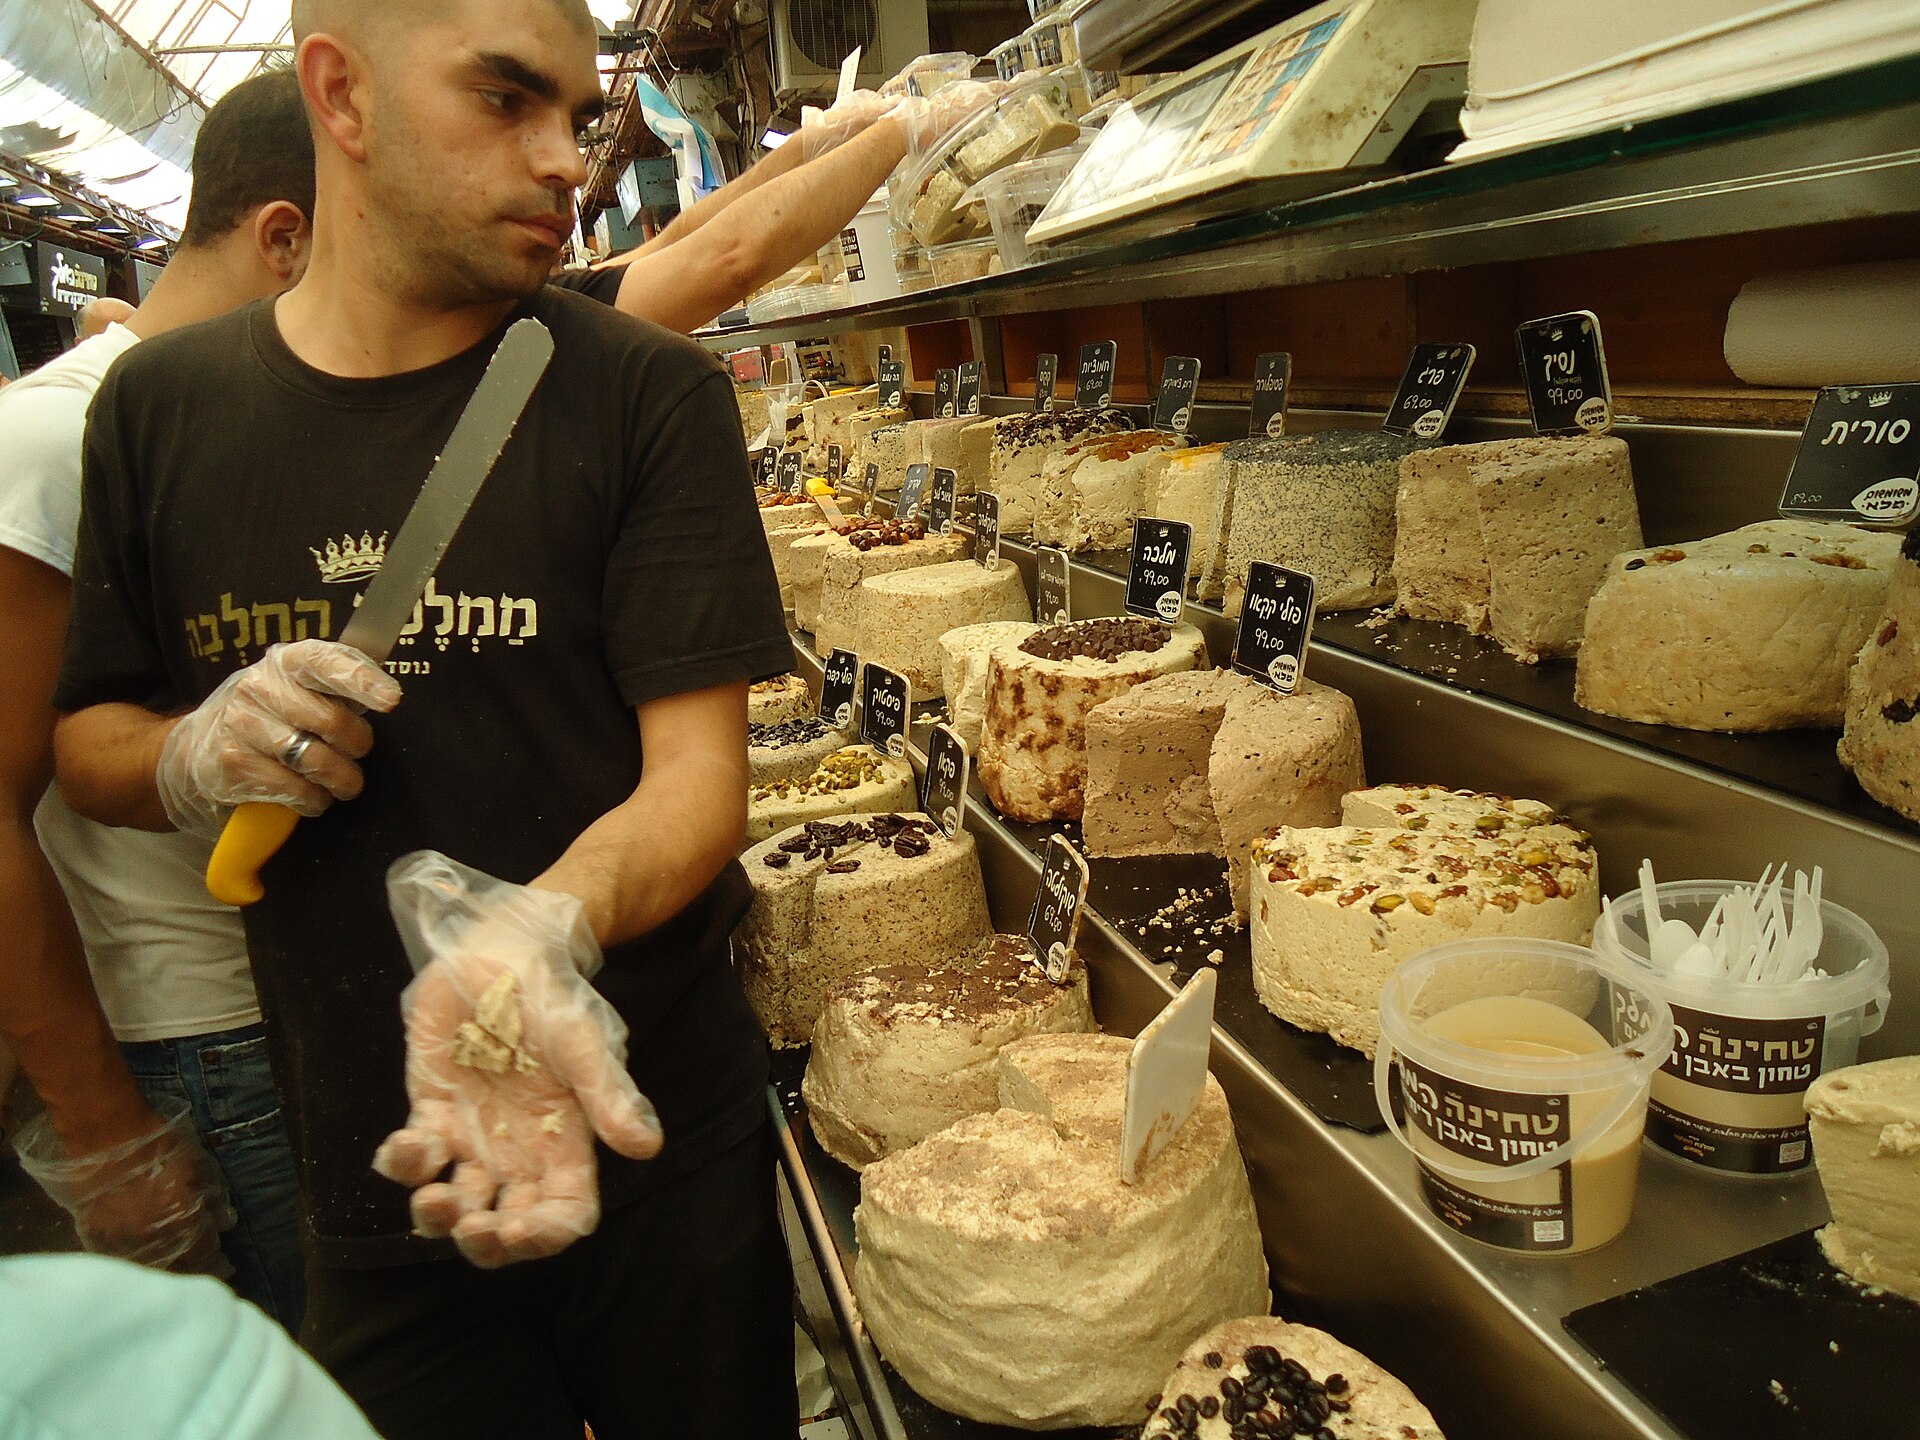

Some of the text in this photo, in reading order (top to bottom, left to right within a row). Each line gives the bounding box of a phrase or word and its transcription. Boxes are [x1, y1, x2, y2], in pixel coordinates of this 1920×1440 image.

[1417, 366, 1445, 386] פרג
[1543, 349, 1575, 382] נסיך
[1403, 394, 1433, 410] 69.00
[1547, 388, 1583, 406] 99.00
[1821, 418, 1911, 445] סורית
[1143, 541, 1177, 565] מלכה
[1143, 569, 1170, 586] 99.00
[1249, 593, 1302, 625] פולי קקאו
[1255, 627, 1284, 650] 99.00
[384, 661, 430, 675] נוסד
[872, 687, 901, 712] פיסטוק
[875, 709, 896, 728] 99.00
[939, 778, 955, 802] 99.00
[1698, 1032, 1815, 1062] טחינה
[1684, 1053, 1751, 1081] באבן
[1757, 1063, 1811, 1089] טחון
[1444, 1095, 1561, 1136] טחינה
[1435, 1116, 1495, 1152] באבן
